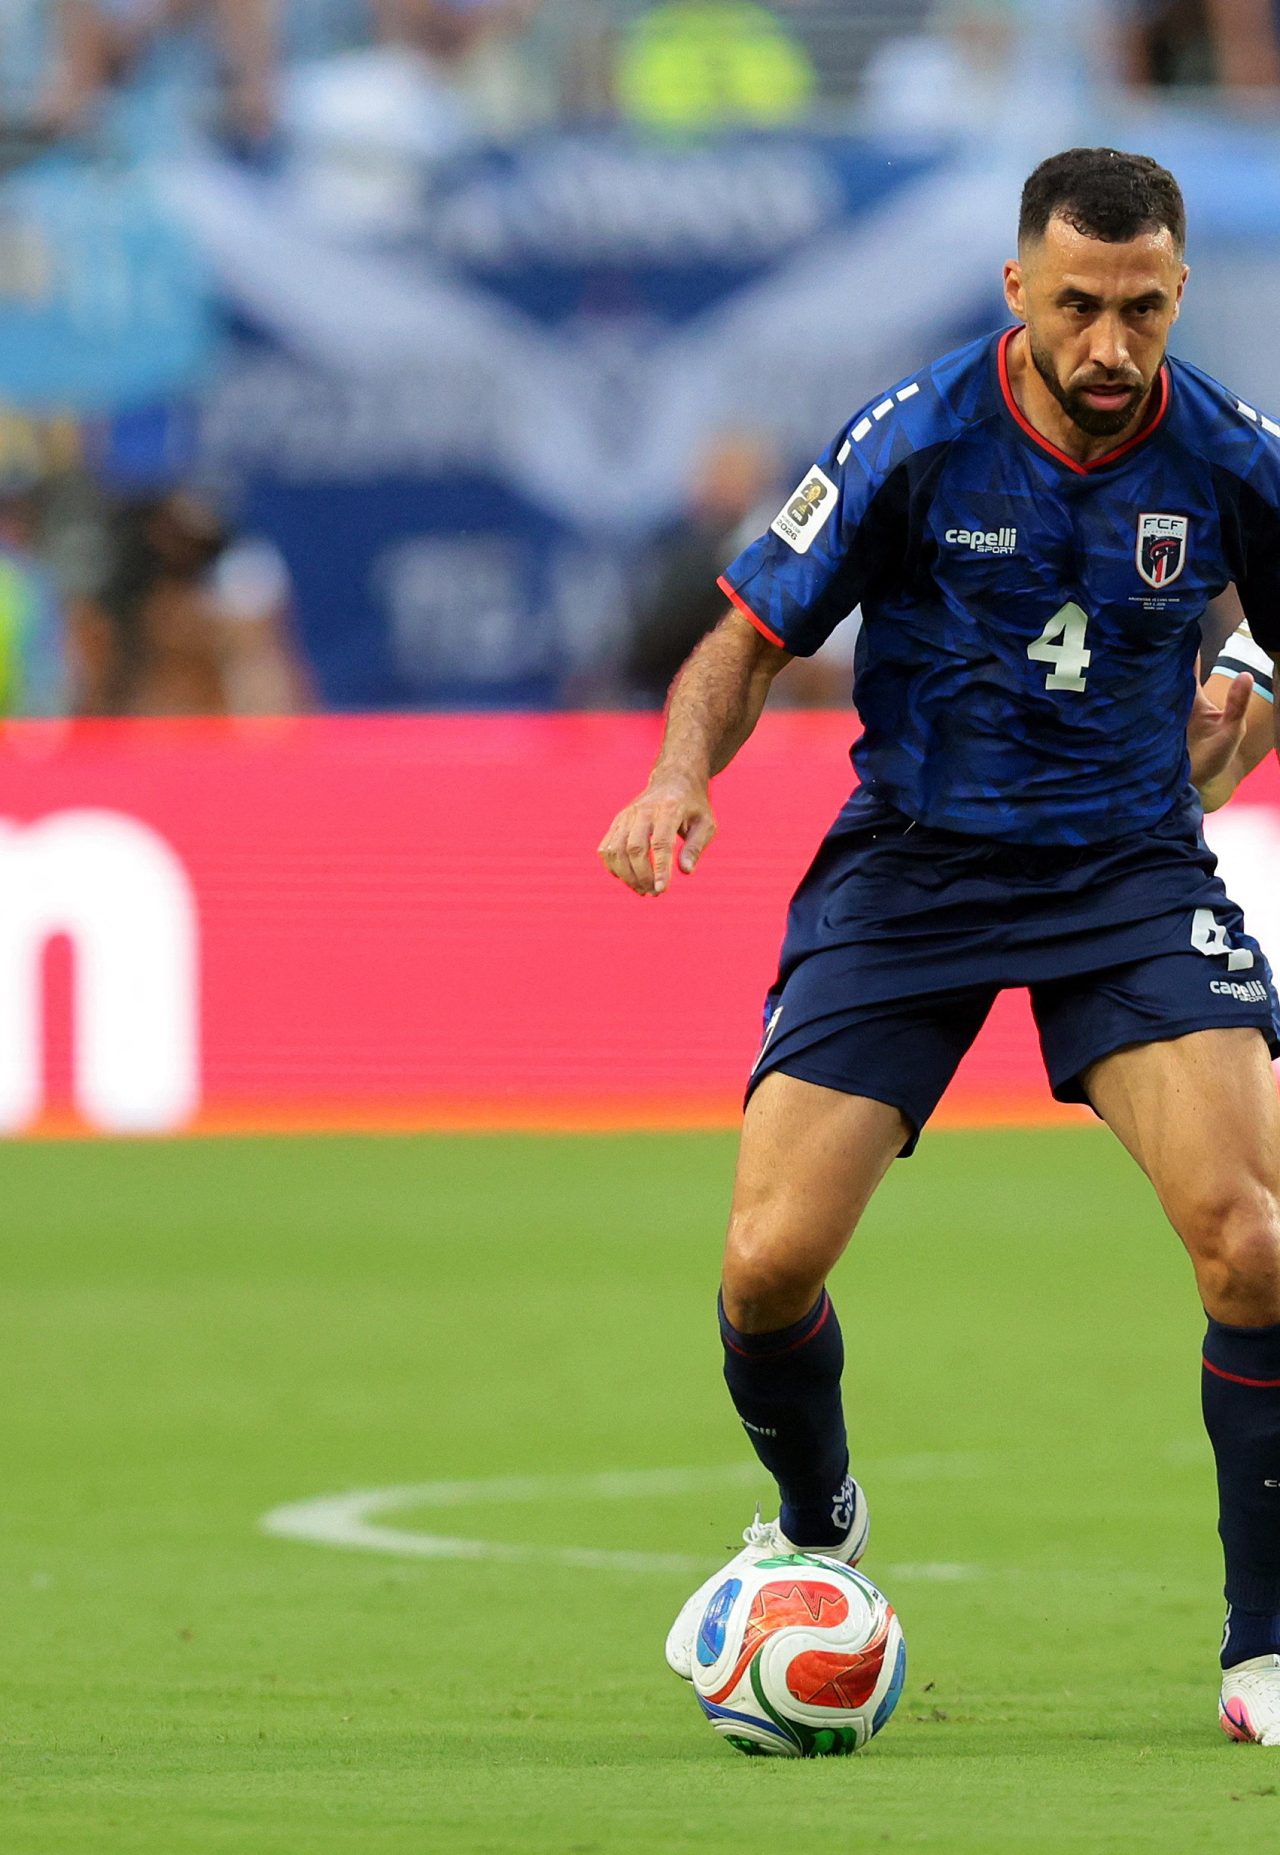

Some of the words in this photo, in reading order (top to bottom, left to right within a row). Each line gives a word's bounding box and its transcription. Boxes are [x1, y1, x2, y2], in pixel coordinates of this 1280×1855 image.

[776, 519, 798, 541] 2026
[1143, 518, 1183, 530] FCF
[945, 527, 1017, 550] capelli
[976, 545, 1015, 554] SPORT
[1026, 601, 1091, 693] 4
[1209, 980, 1268, 1000] capelli
